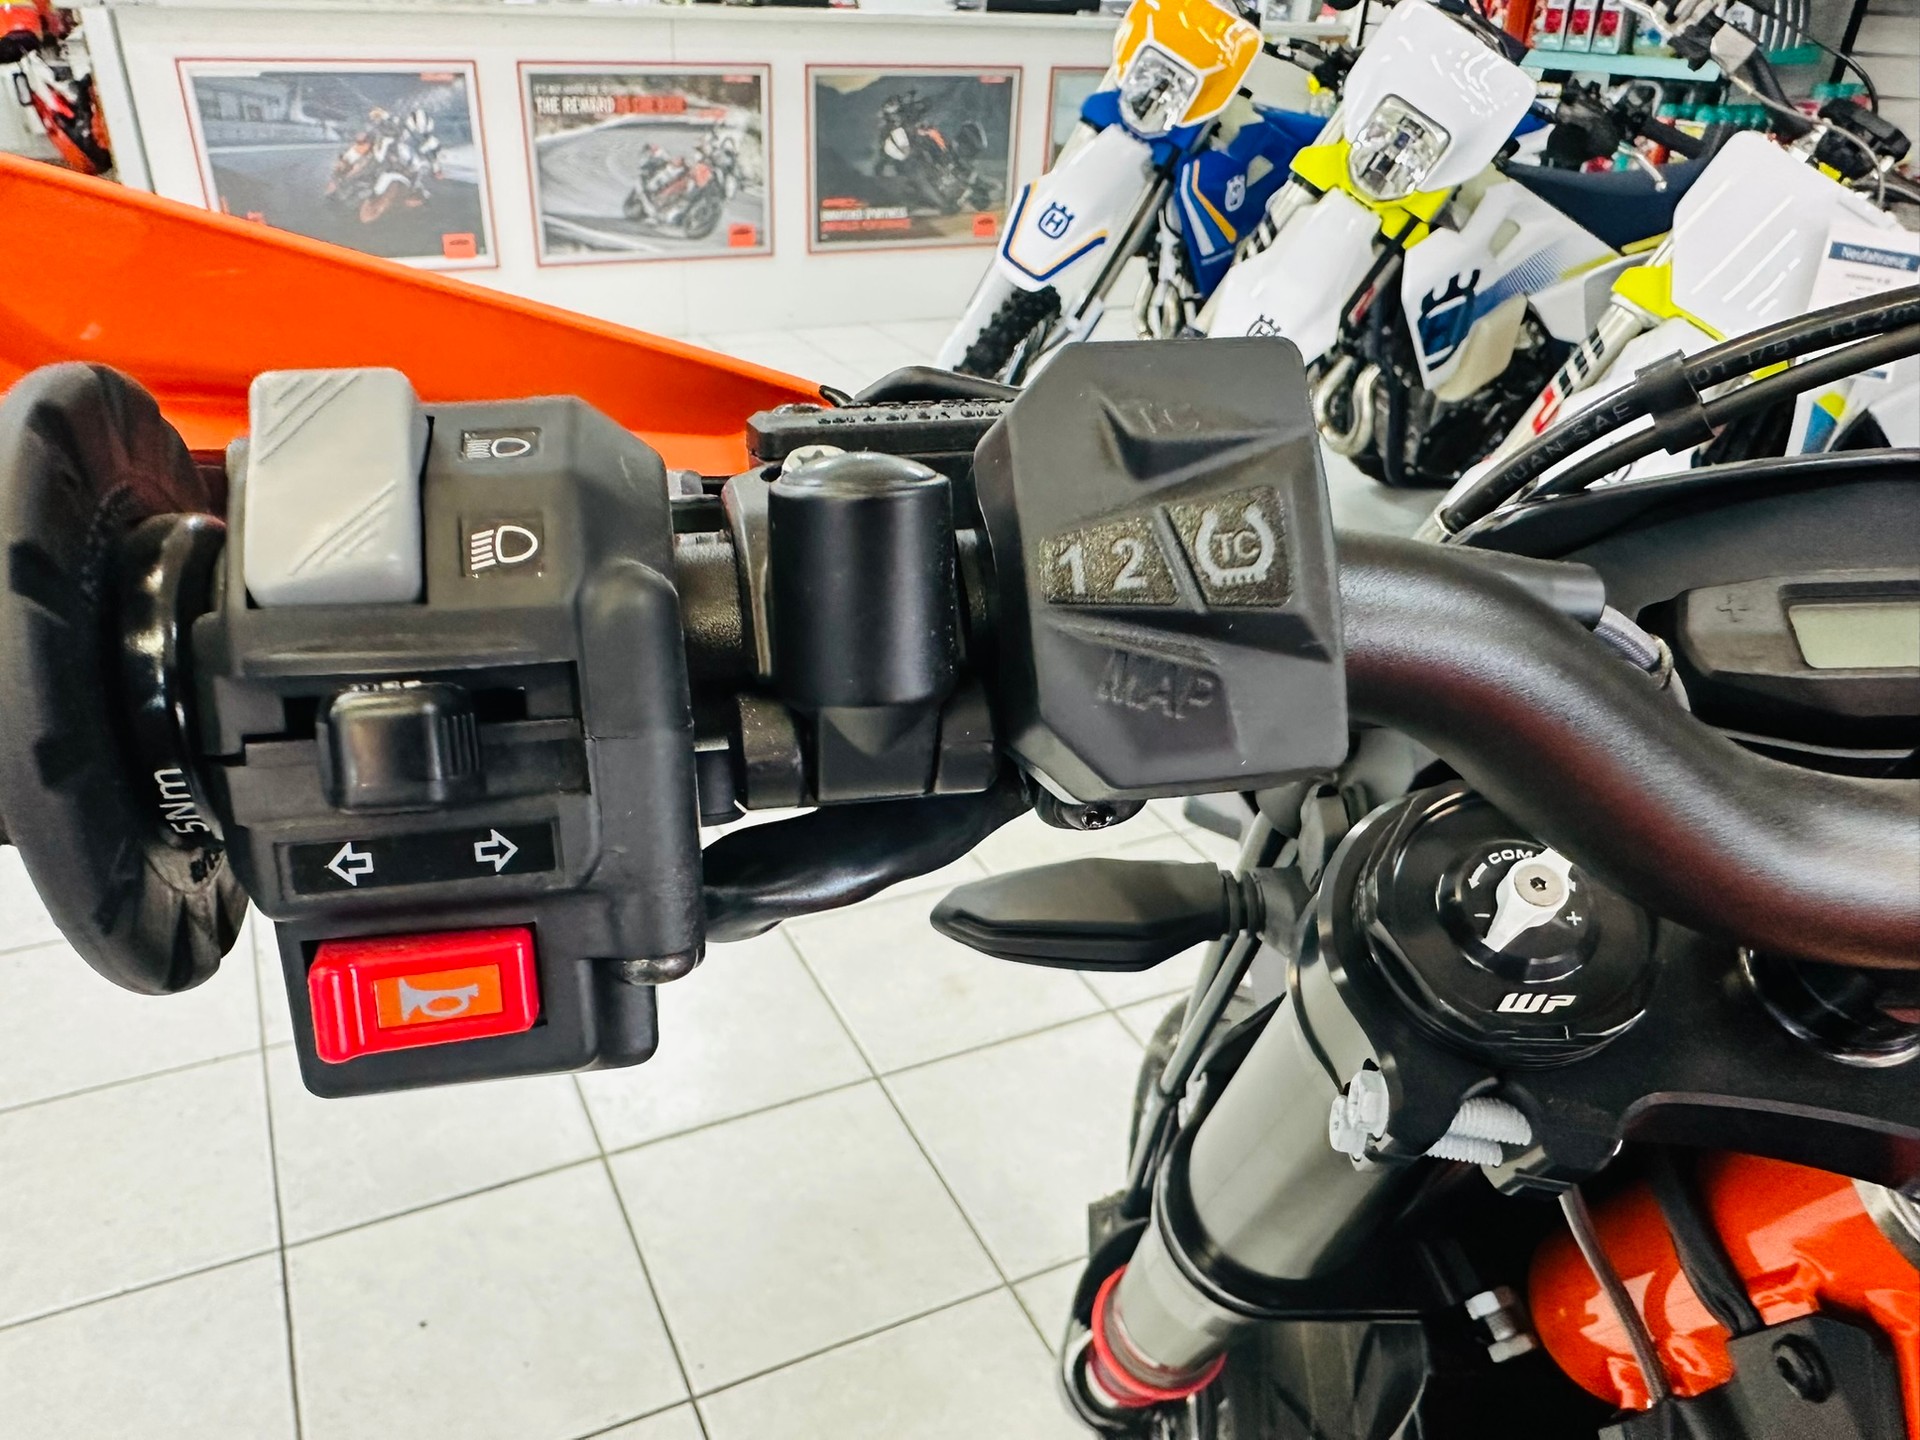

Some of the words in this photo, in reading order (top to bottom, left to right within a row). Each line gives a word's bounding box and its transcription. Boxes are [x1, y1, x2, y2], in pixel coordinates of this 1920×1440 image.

[1572, 400, 1633, 439] SAE
[1212, 529, 1261, 562] TC
[1058, 542, 1088, 596] 1
[1111, 536, 1149, 591] 2
[153, 767, 211, 834] 5Nm
[1487, 848, 1541, 866] COM
[1496, 992, 1577, 1014] WP
